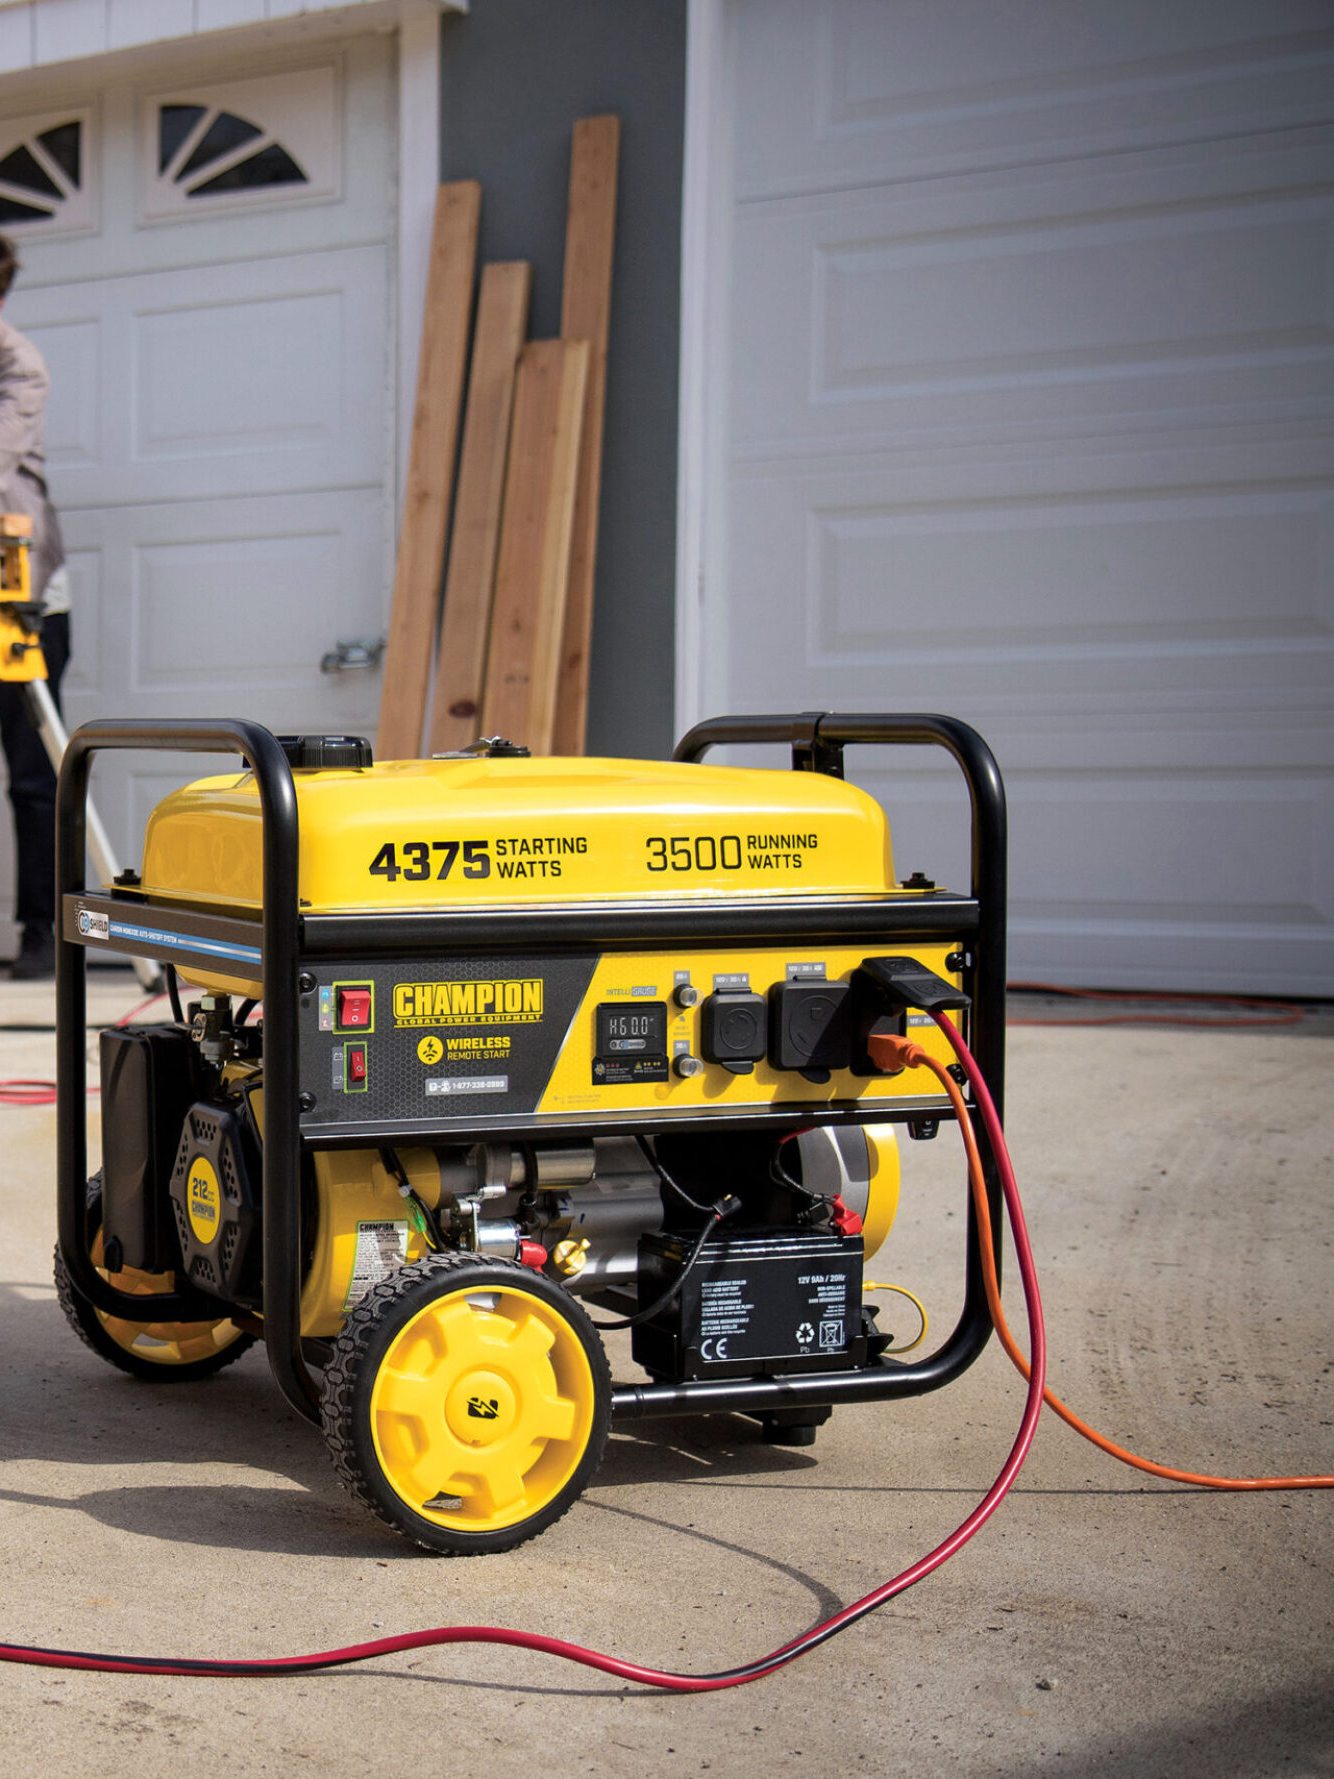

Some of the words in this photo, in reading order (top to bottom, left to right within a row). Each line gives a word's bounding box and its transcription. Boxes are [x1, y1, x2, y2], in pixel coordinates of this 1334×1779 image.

[496, 837, 588, 856] STARTING
[747, 834, 818, 850] RUNNING
[646, 835, 742, 871] 3500
[368, 840, 491, 882] 4375
[747, 854, 802, 869] WATTS
[496, 860, 562, 878] WATTS
[89, 917, 108, 932] SHIELD
[395, 981, 542, 1017] CHAMPION
[396, 1018, 437, 1026] GLOBAL
[480, 1014, 541, 1022] EQUIPMENT
[446, 1036, 511, 1050] WIRELESS
[447, 1051, 482, 1061] REMOTE
[483, 1049, 510, 1060] START
[359, 1223, 394, 1232] CHAMPION
[797, 1276, 810, 1284] 12V
[829, 1273, 846, 1282] 20Hr
